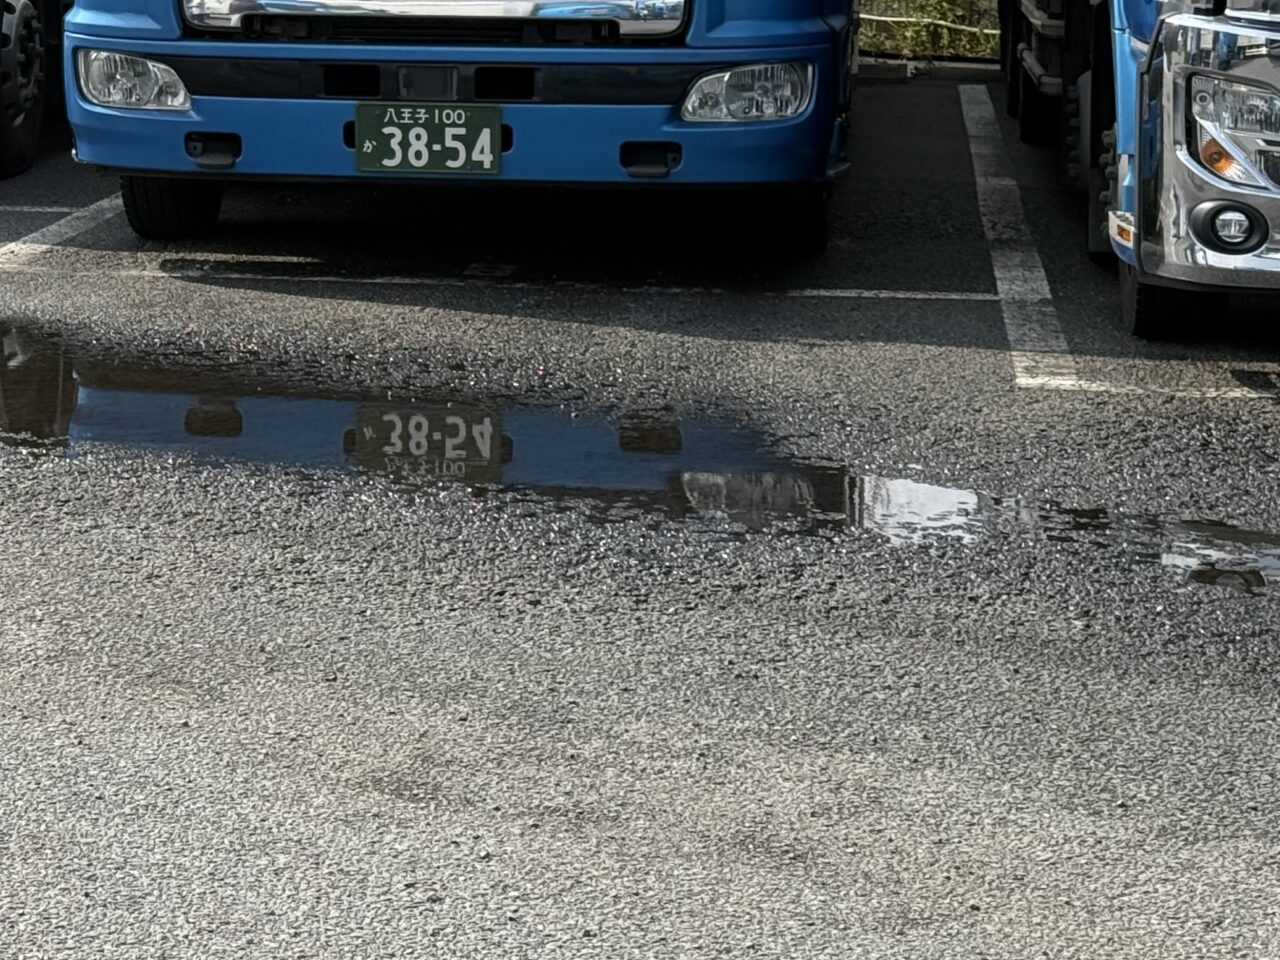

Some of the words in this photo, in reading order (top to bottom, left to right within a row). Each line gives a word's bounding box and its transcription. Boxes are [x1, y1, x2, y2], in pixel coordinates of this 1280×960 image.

[383, 108, 430, 124] 八王子
[434, 109, 466, 125] 100
[362, 139, 377, 153] か
[381, 126, 494, 169] 38-54
